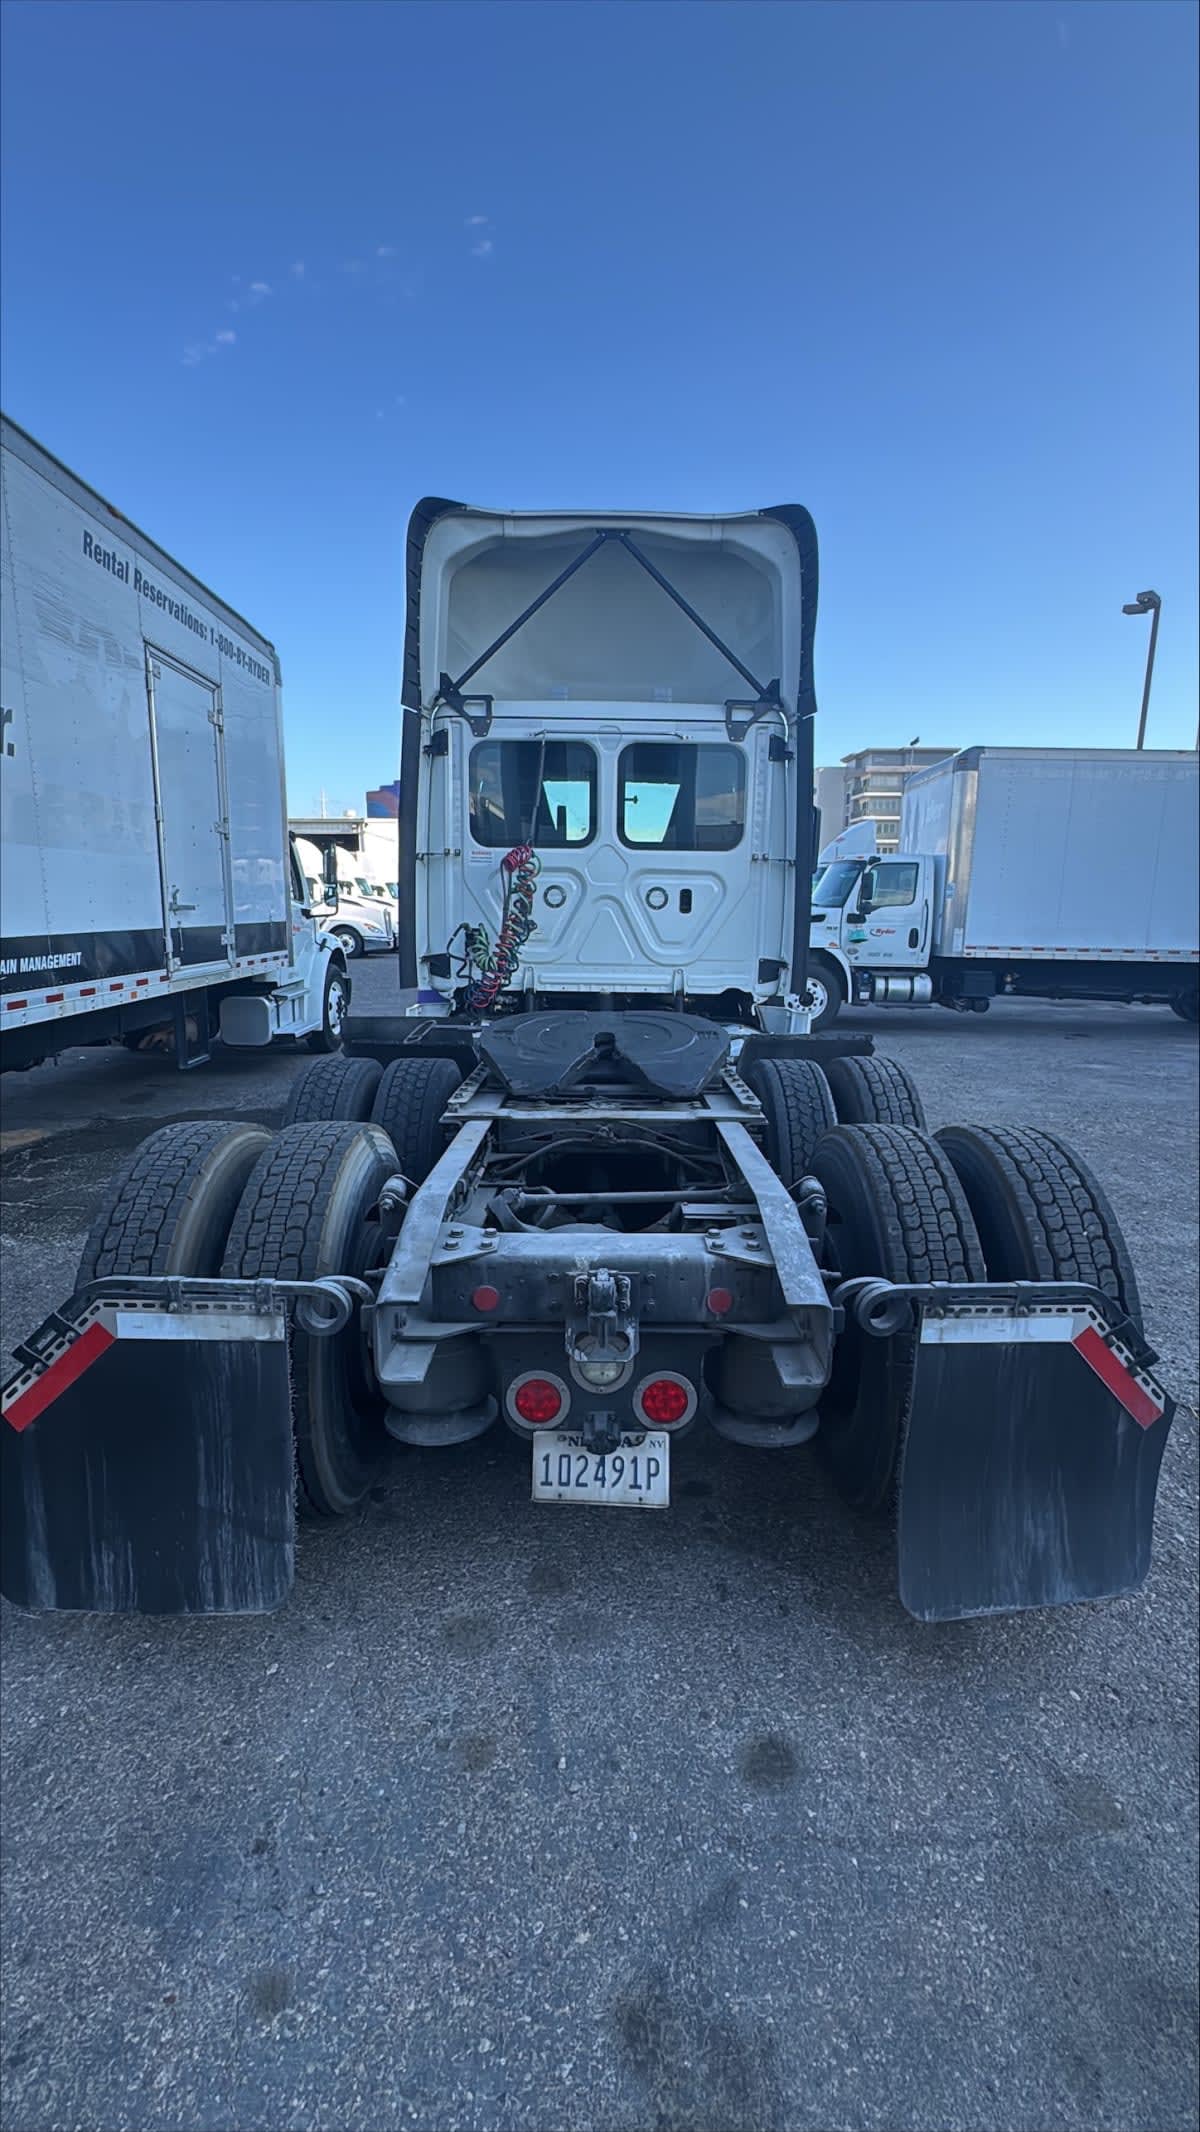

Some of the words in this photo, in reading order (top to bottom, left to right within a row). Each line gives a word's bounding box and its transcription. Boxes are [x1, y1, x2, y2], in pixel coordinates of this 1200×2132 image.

[83, 530, 129, 585] Rental
[134, 567, 208, 641] Reservations:
[20, 951, 82, 973] MANAGEMENT
[649, 1439, 664, 1448] NV
[540, 1453, 660, 1491] 102491P
